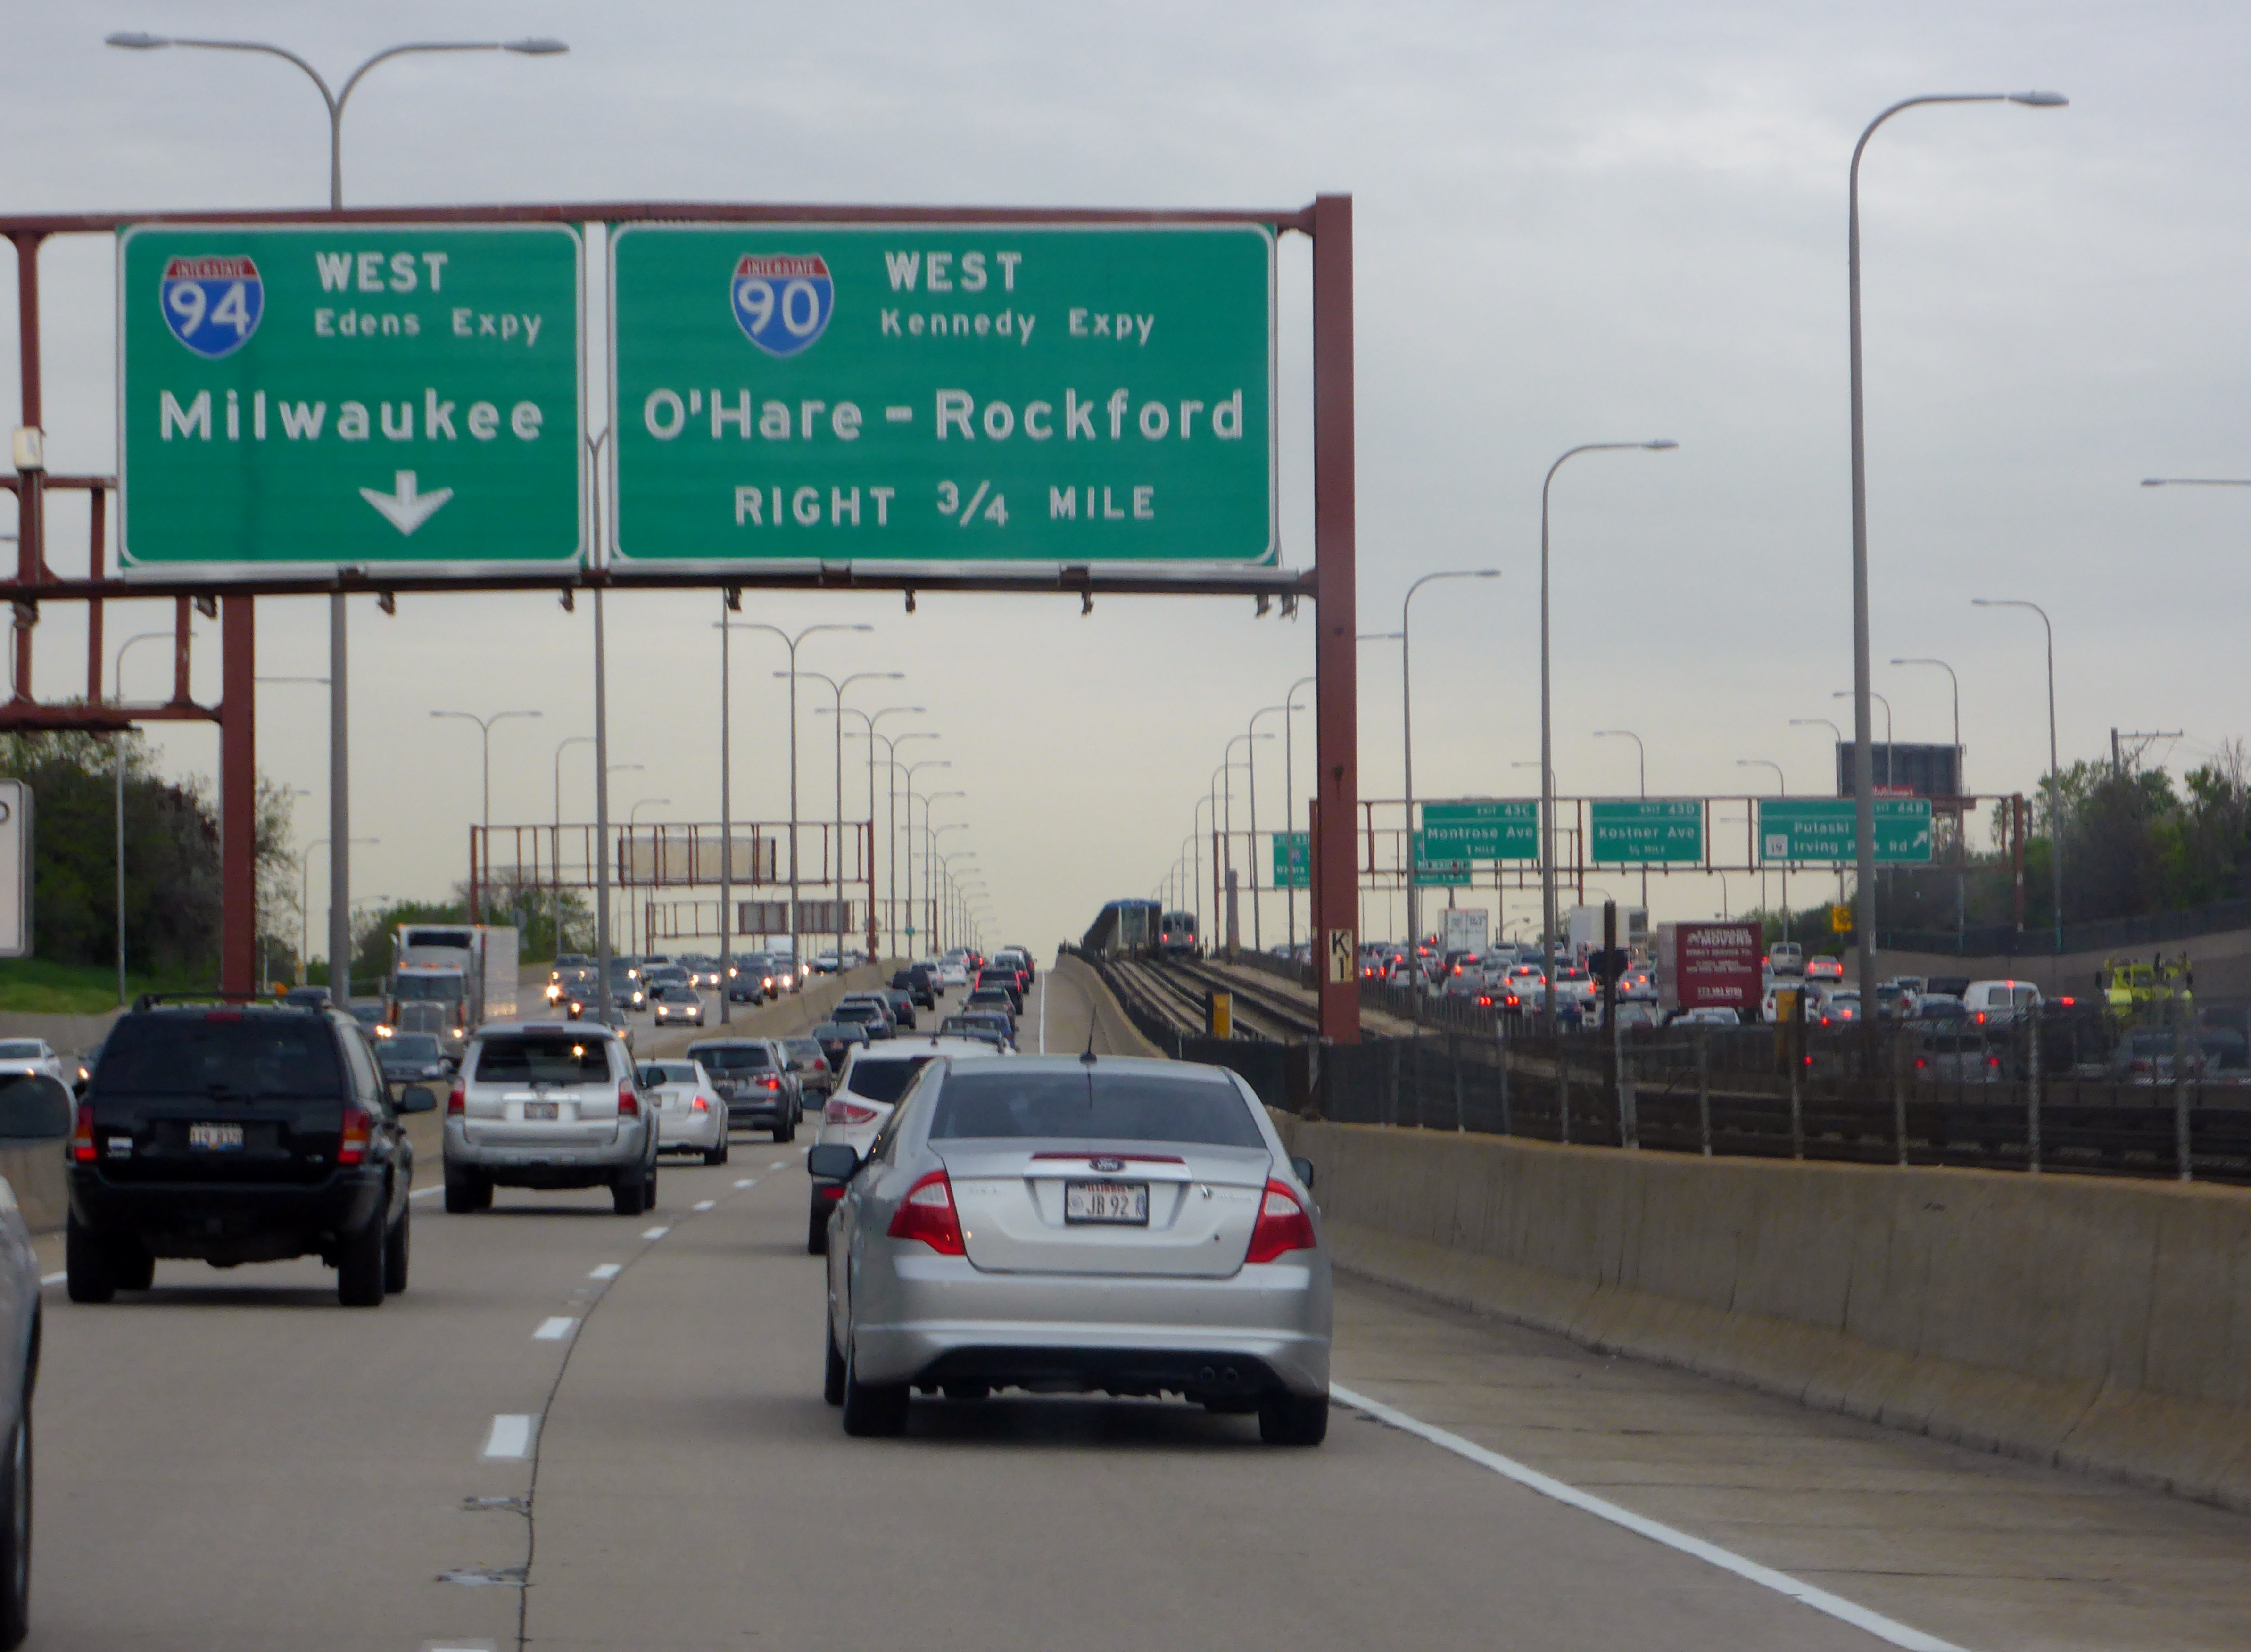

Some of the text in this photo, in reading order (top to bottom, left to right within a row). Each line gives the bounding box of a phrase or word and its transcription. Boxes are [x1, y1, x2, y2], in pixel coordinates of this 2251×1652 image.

[316, 252, 447, 292] WEST
[747, 259, 816, 276] INTERSTATE
[885, 252, 1021, 291] WEST
[169, 281, 251, 338] 94
[315, 308, 542, 346] Edens Expy
[738, 279, 819, 338] 90
[881, 308, 1154, 346] Kennedy Expy
[160, 388, 543, 441] Milwaukee
[644, 388, 1243, 440] O'Hare - Rockford
[735, 486, 895, 526] RIGHT
[1050, 486, 1153, 519] MILE
[1428, 826, 1533, 840] Montrose Ave
[1599, 826, 1695, 839] Kostner Ave
[1794, 822, 1849, 834] Pulaski
[1795, 840, 1838, 855] Irving
[1889, 840, 1908, 853] Rd
[1332, 930, 1349, 958] K
[1701, 934, 1753, 947] MOVERS
